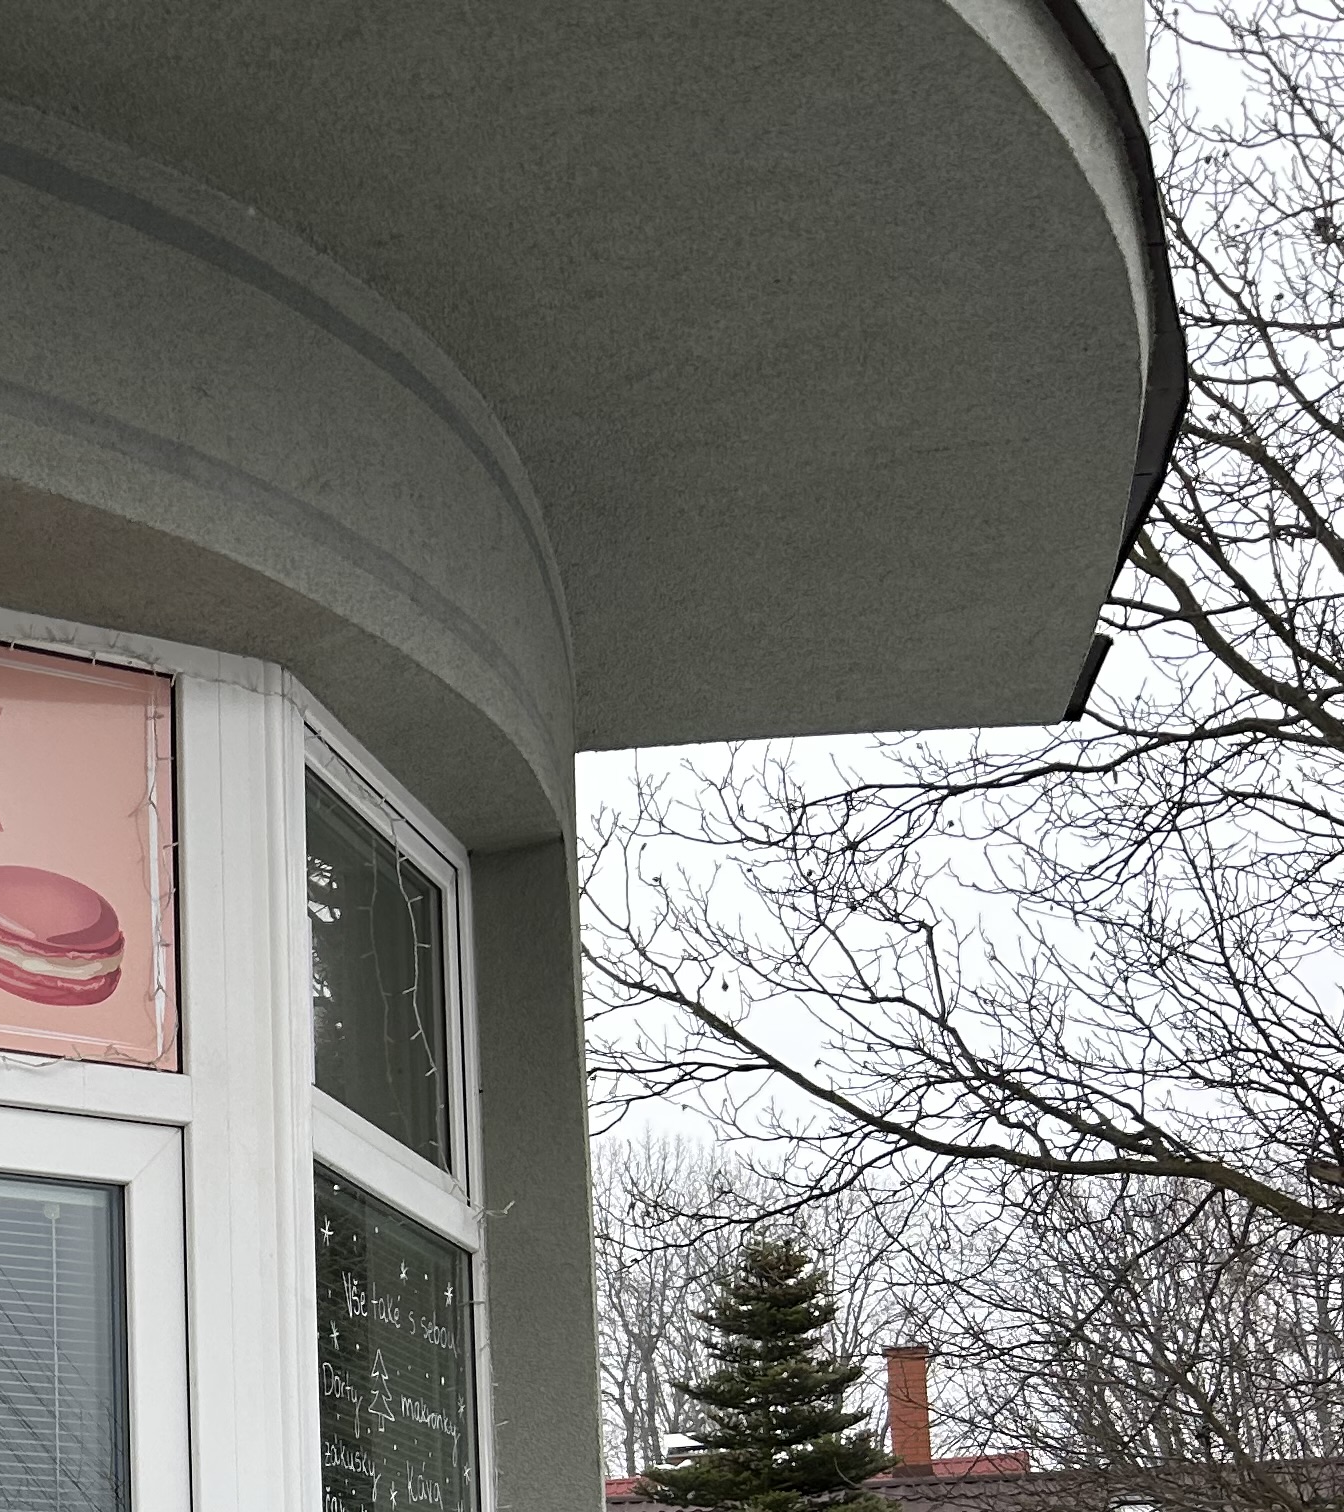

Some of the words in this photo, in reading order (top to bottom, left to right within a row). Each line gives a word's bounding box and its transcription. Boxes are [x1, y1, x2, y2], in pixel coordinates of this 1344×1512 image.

[342, 1271, 368, 1318] Vše
[371, 1281, 401, 1329] také
[420, 1311, 458, 1358] sebou
[322, 1362, 363, 1439] Dorty
